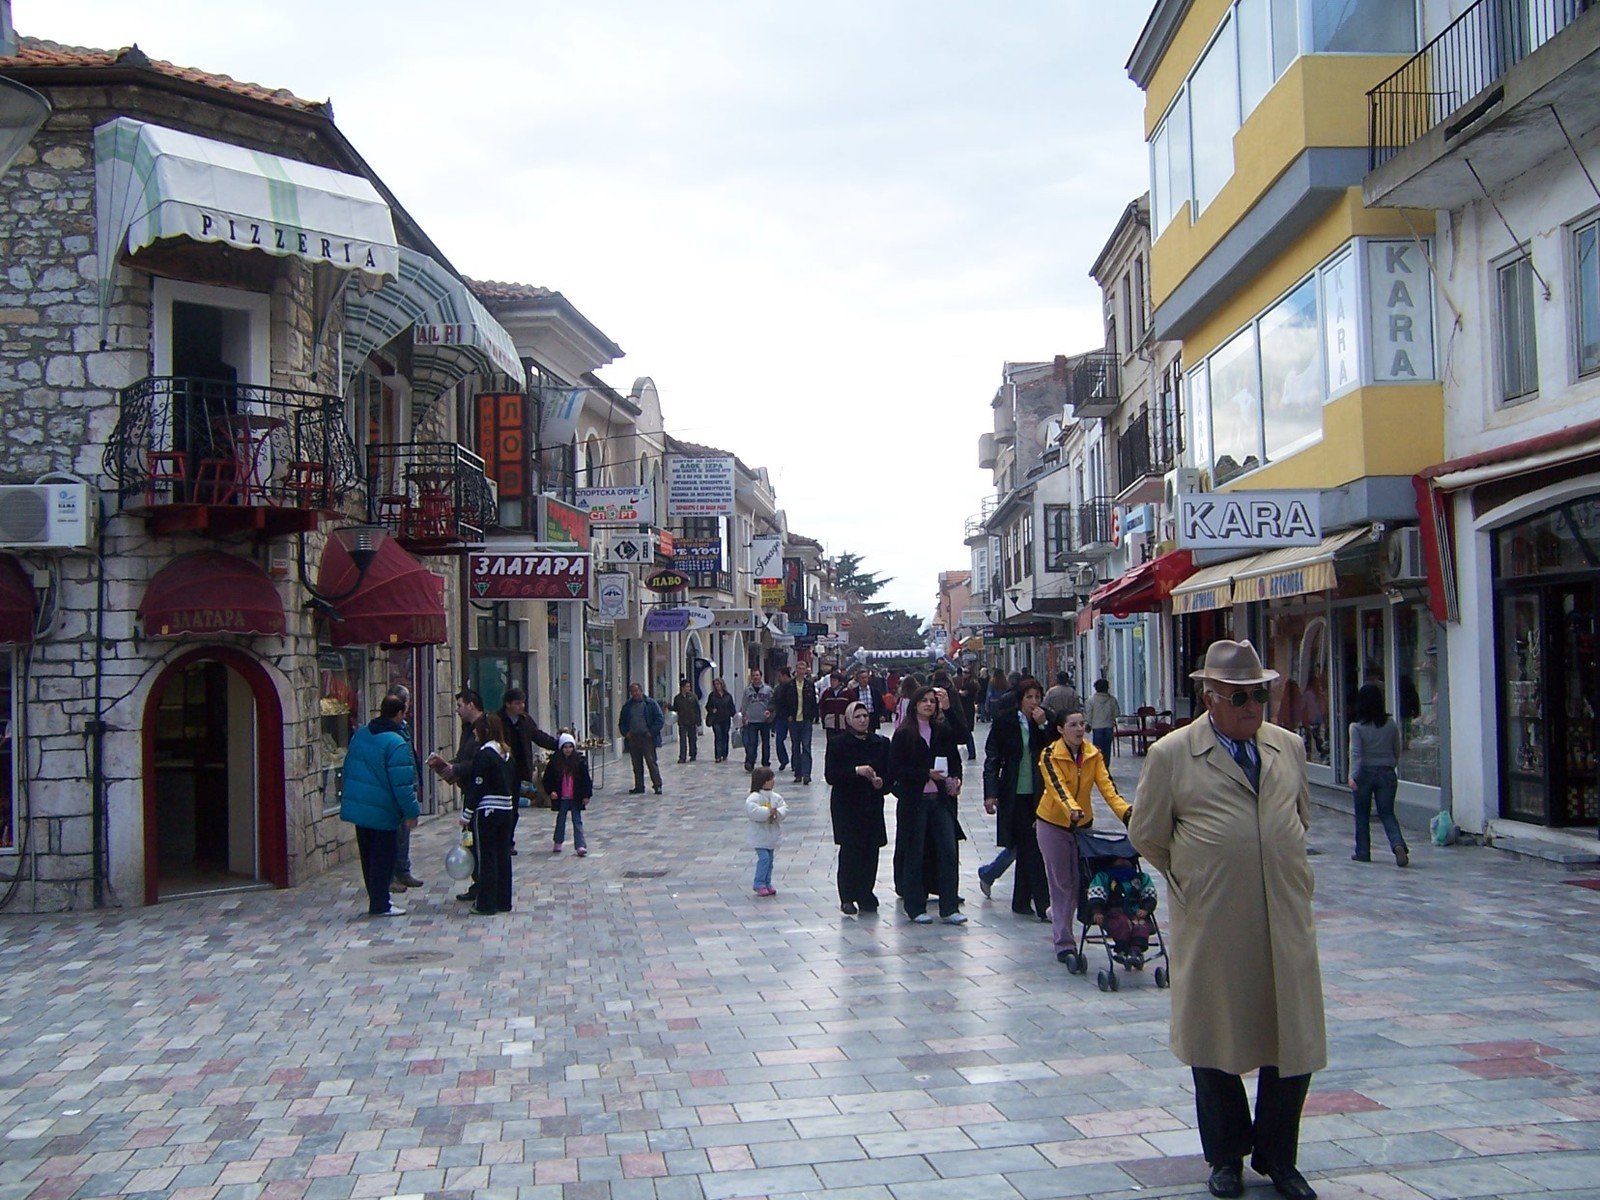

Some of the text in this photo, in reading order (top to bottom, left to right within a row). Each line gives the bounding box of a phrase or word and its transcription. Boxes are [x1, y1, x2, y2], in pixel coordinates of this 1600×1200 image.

[201, 213, 376, 269] PIZZERIA
[1385, 245, 1417, 377] KARA
[418, 324, 462, 344] ALPI
[1334, 266, 1348, 386] KARA
[575, 488, 649, 497] СПОРТСКА ОПРЕА
[1184, 500, 1316, 539] KARA
[475, 557, 584, 576] ЗЛАТАРА
[652, 576, 682, 586] ЛАВО
[172, 608, 245, 629] ЗЛАТАРА
[872, 650, 929, 659] IMPULS
